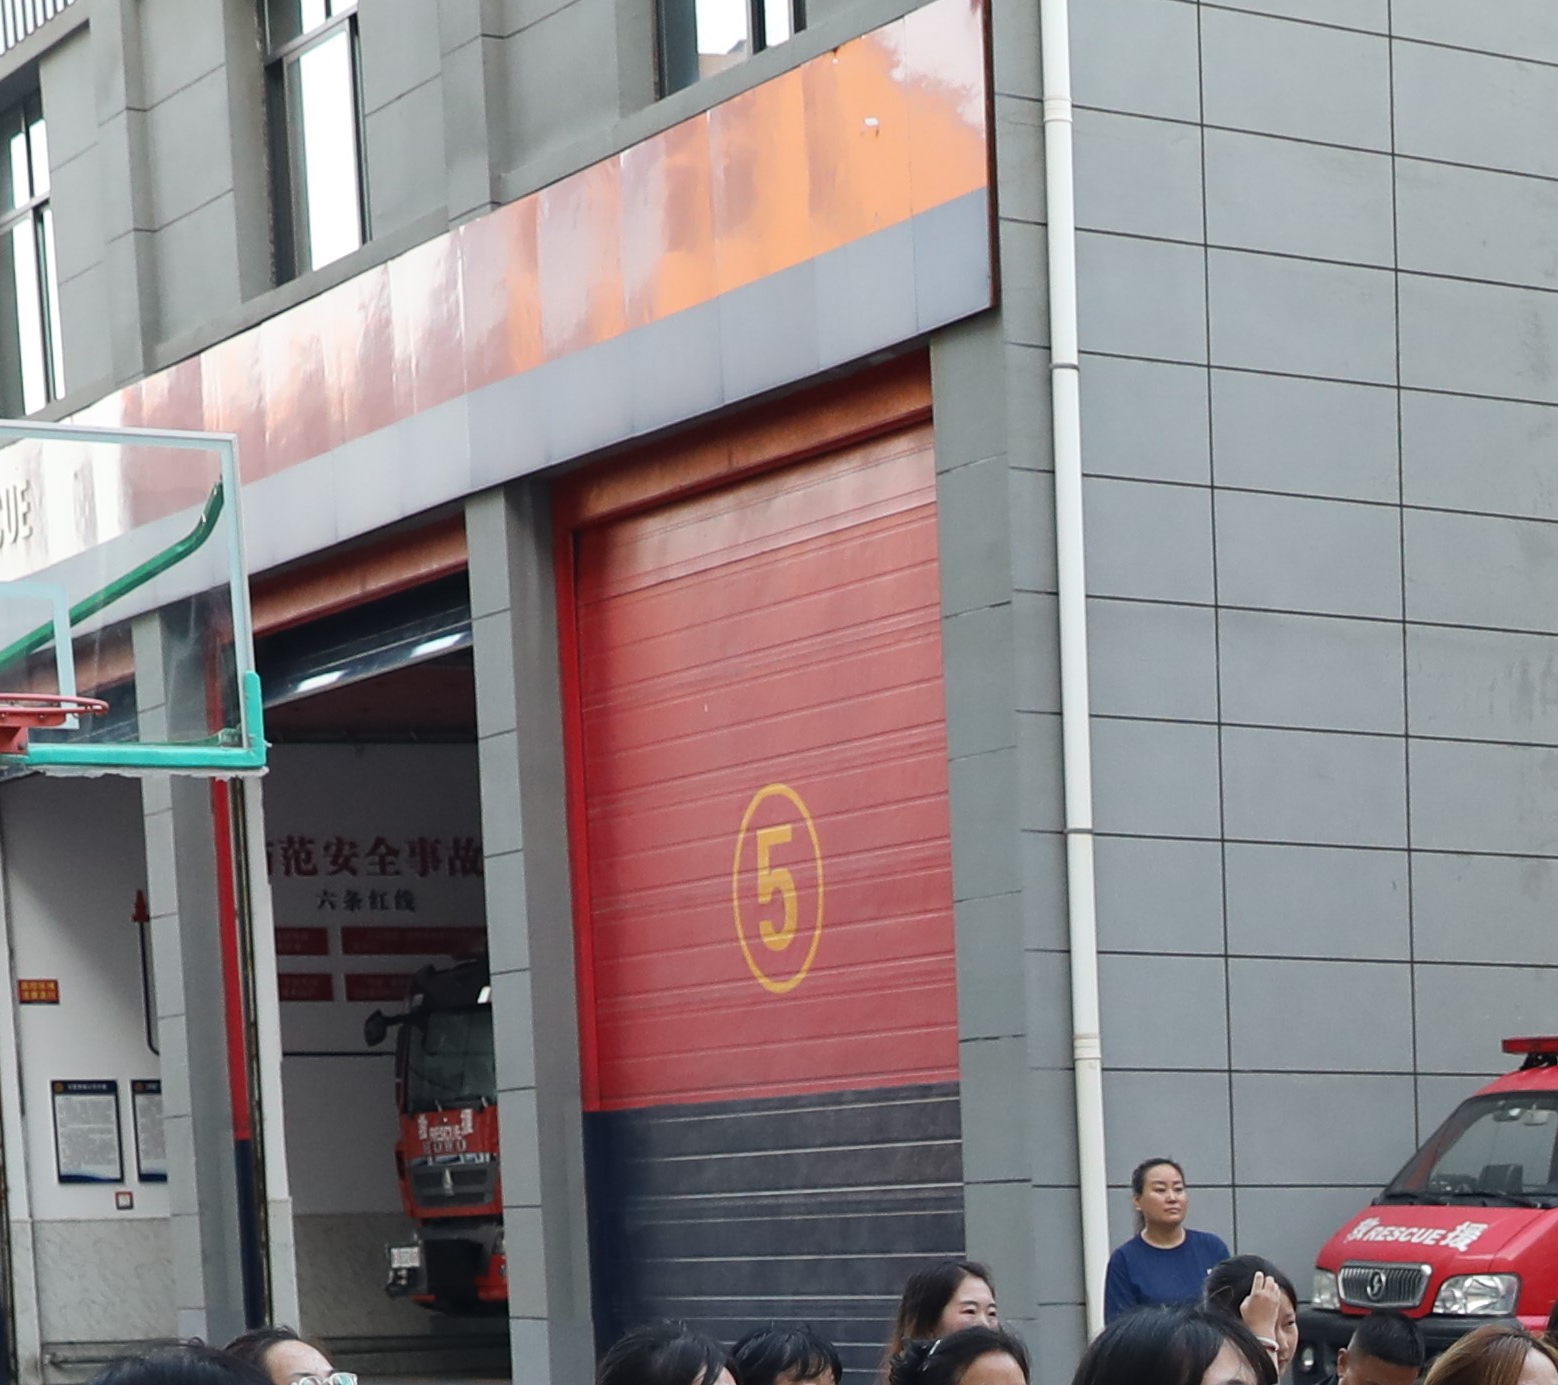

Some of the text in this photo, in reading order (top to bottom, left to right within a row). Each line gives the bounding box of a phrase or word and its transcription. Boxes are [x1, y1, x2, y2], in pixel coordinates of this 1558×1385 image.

[316, 888, 417, 912] 六条红线
[756, 823, 799, 952] 5
